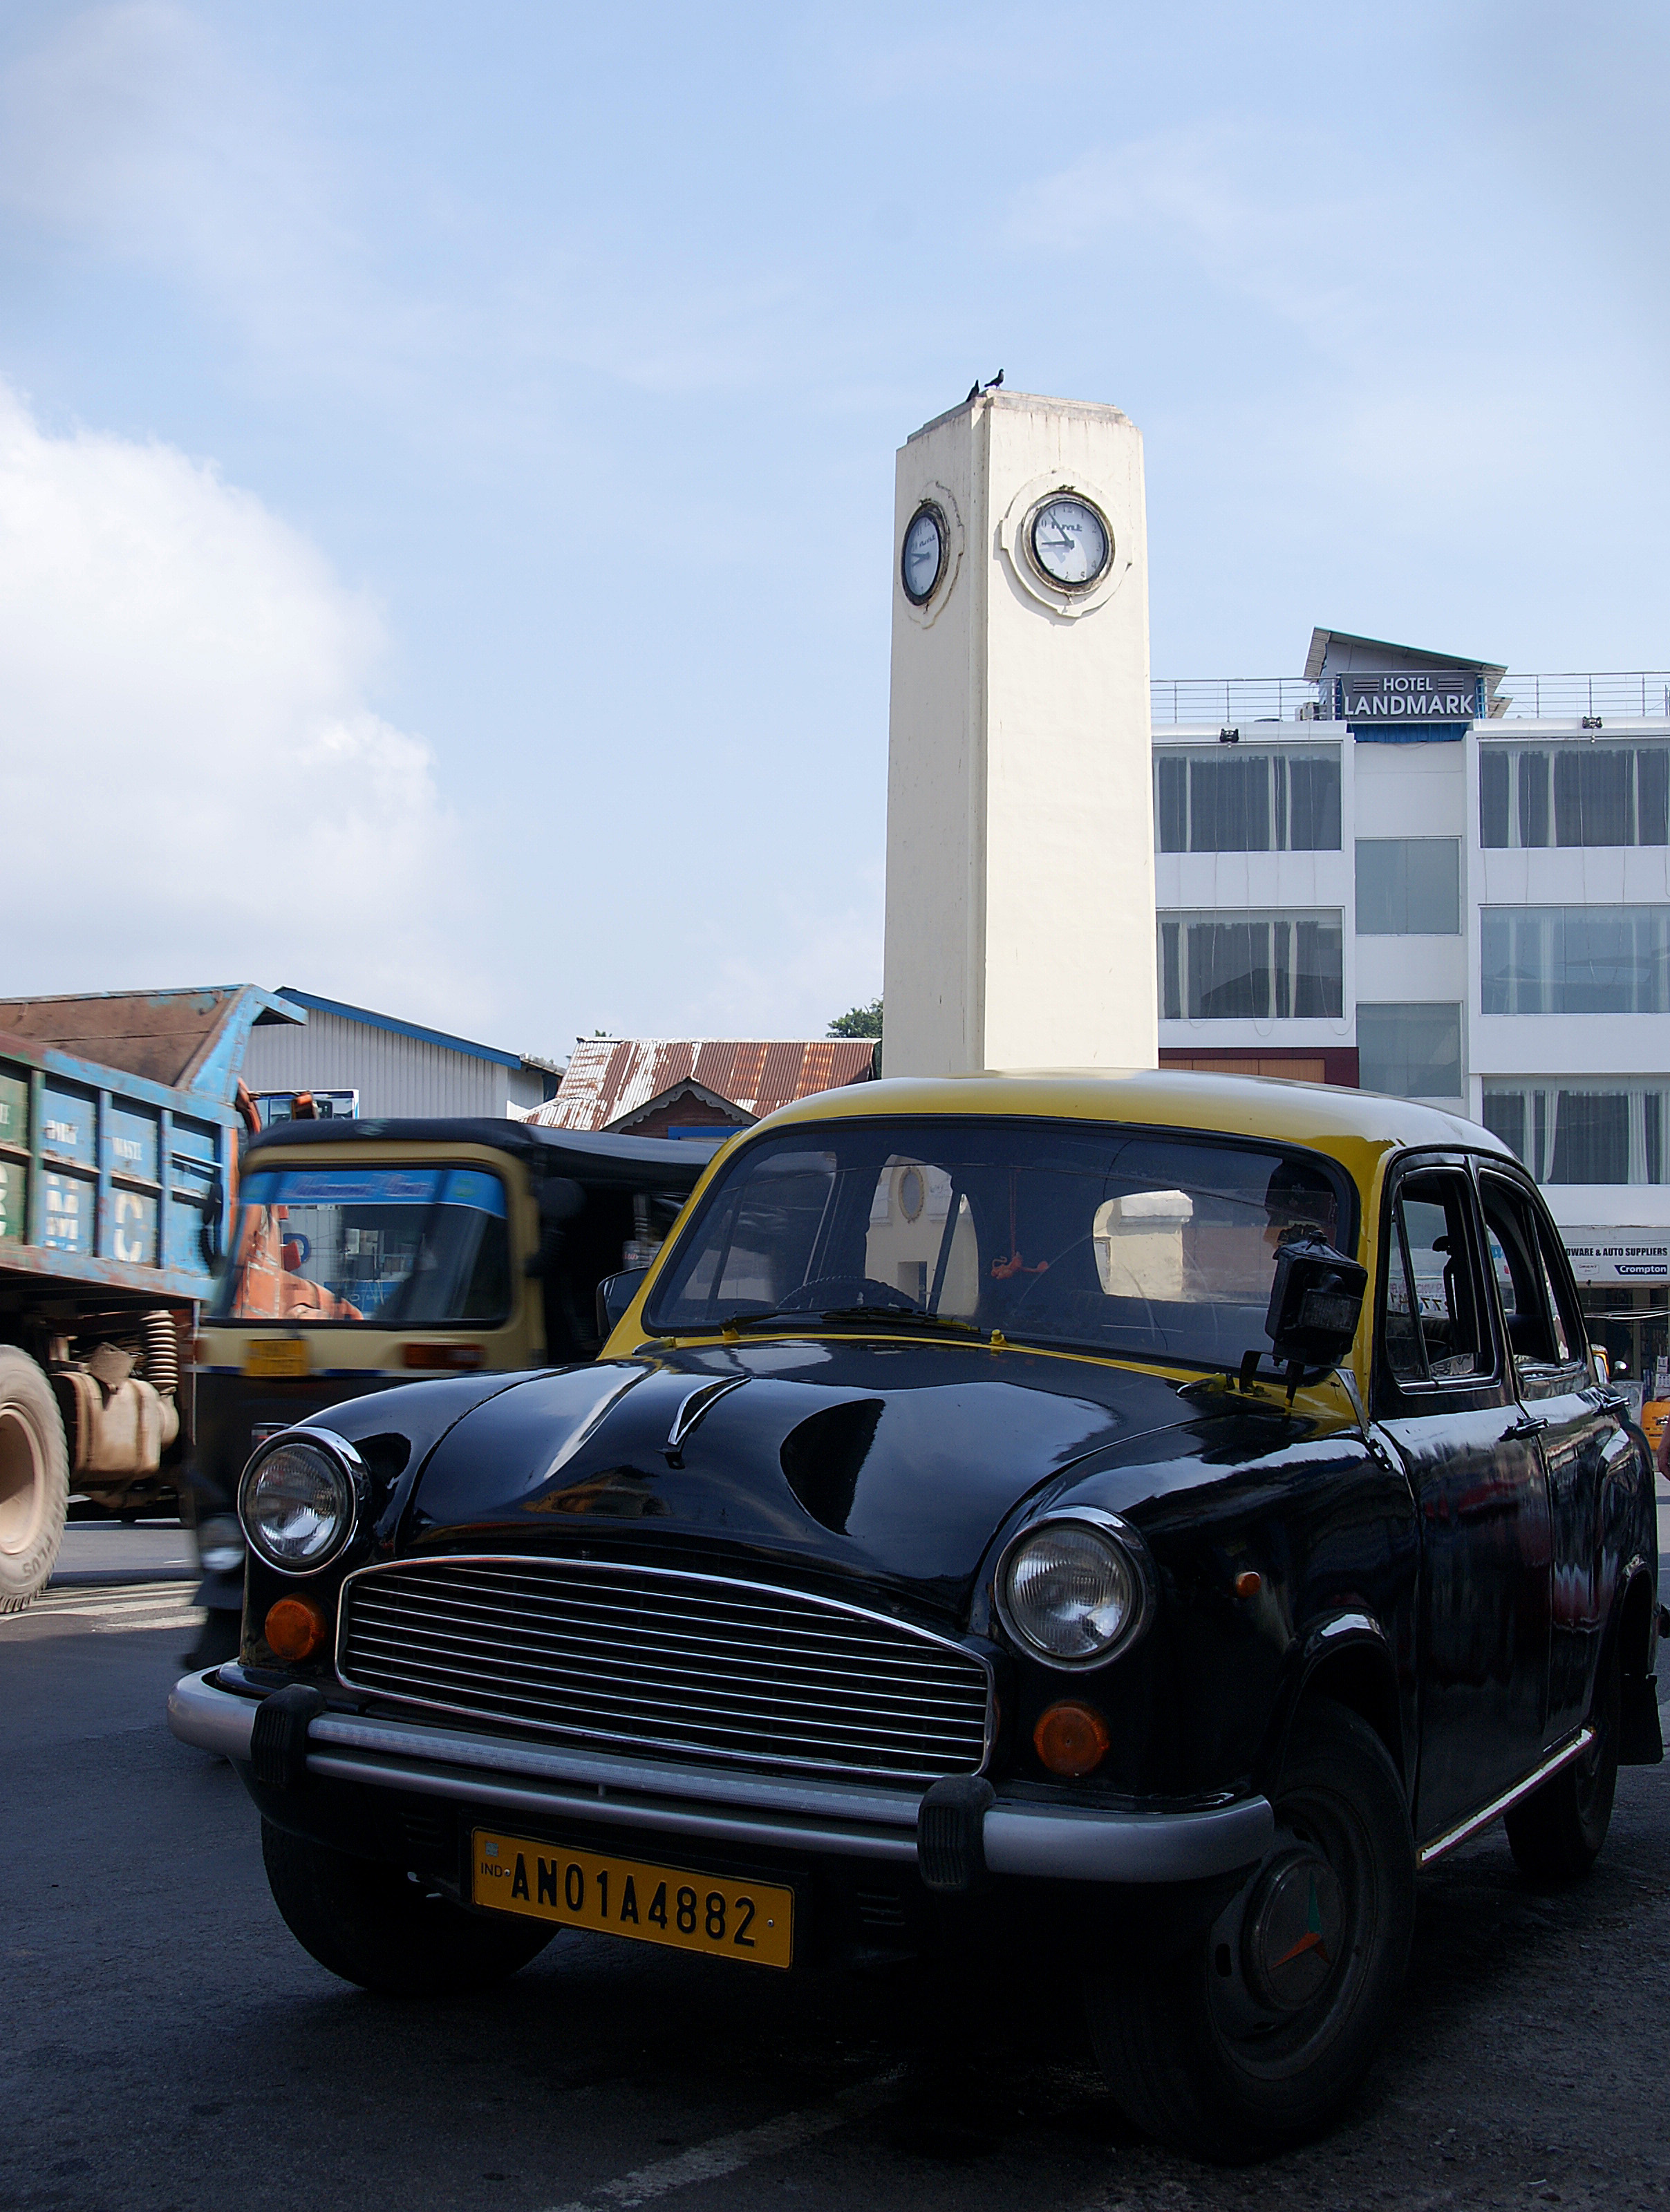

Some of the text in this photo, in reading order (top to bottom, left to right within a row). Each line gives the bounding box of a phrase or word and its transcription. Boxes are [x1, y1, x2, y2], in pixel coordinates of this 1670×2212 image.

[1383, 677, 1433, 691] HOTEL
[1344, 695, 1474, 715] LANDMARK
[1603, 1248, 1624, 1256] AUTO
[1625, 1247, 1668, 1256] SUPPLIERS
[1620, 1266, 1667, 1274] Crompton
[481, 1862, 503, 1877] IND
[512, 1852, 756, 1947] AN01A4882
